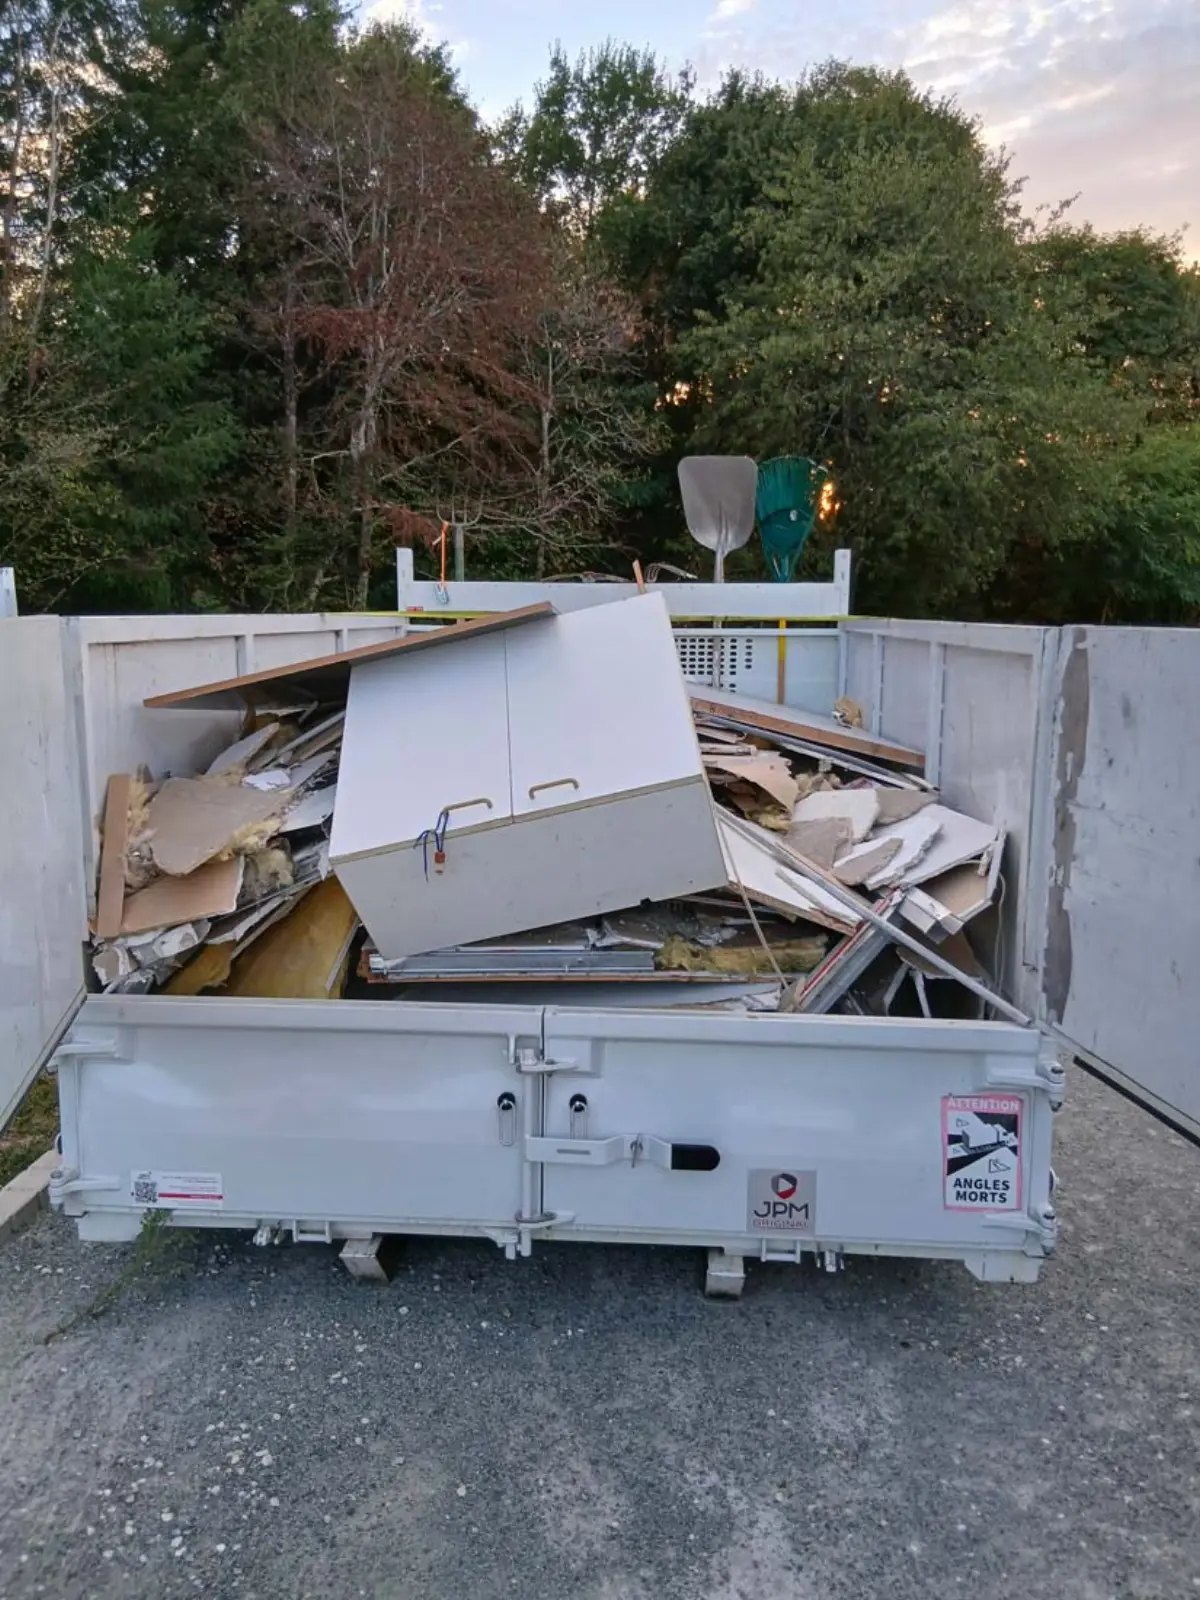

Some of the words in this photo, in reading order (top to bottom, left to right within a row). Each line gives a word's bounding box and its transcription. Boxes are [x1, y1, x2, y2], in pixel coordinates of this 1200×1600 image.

[948, 1098, 1019, 1111] ATTENTION
[953, 1178, 1010, 1191] ANGLES
[955, 1190, 1008, 1203] MORTS
[753, 1201, 809, 1219] JPM
